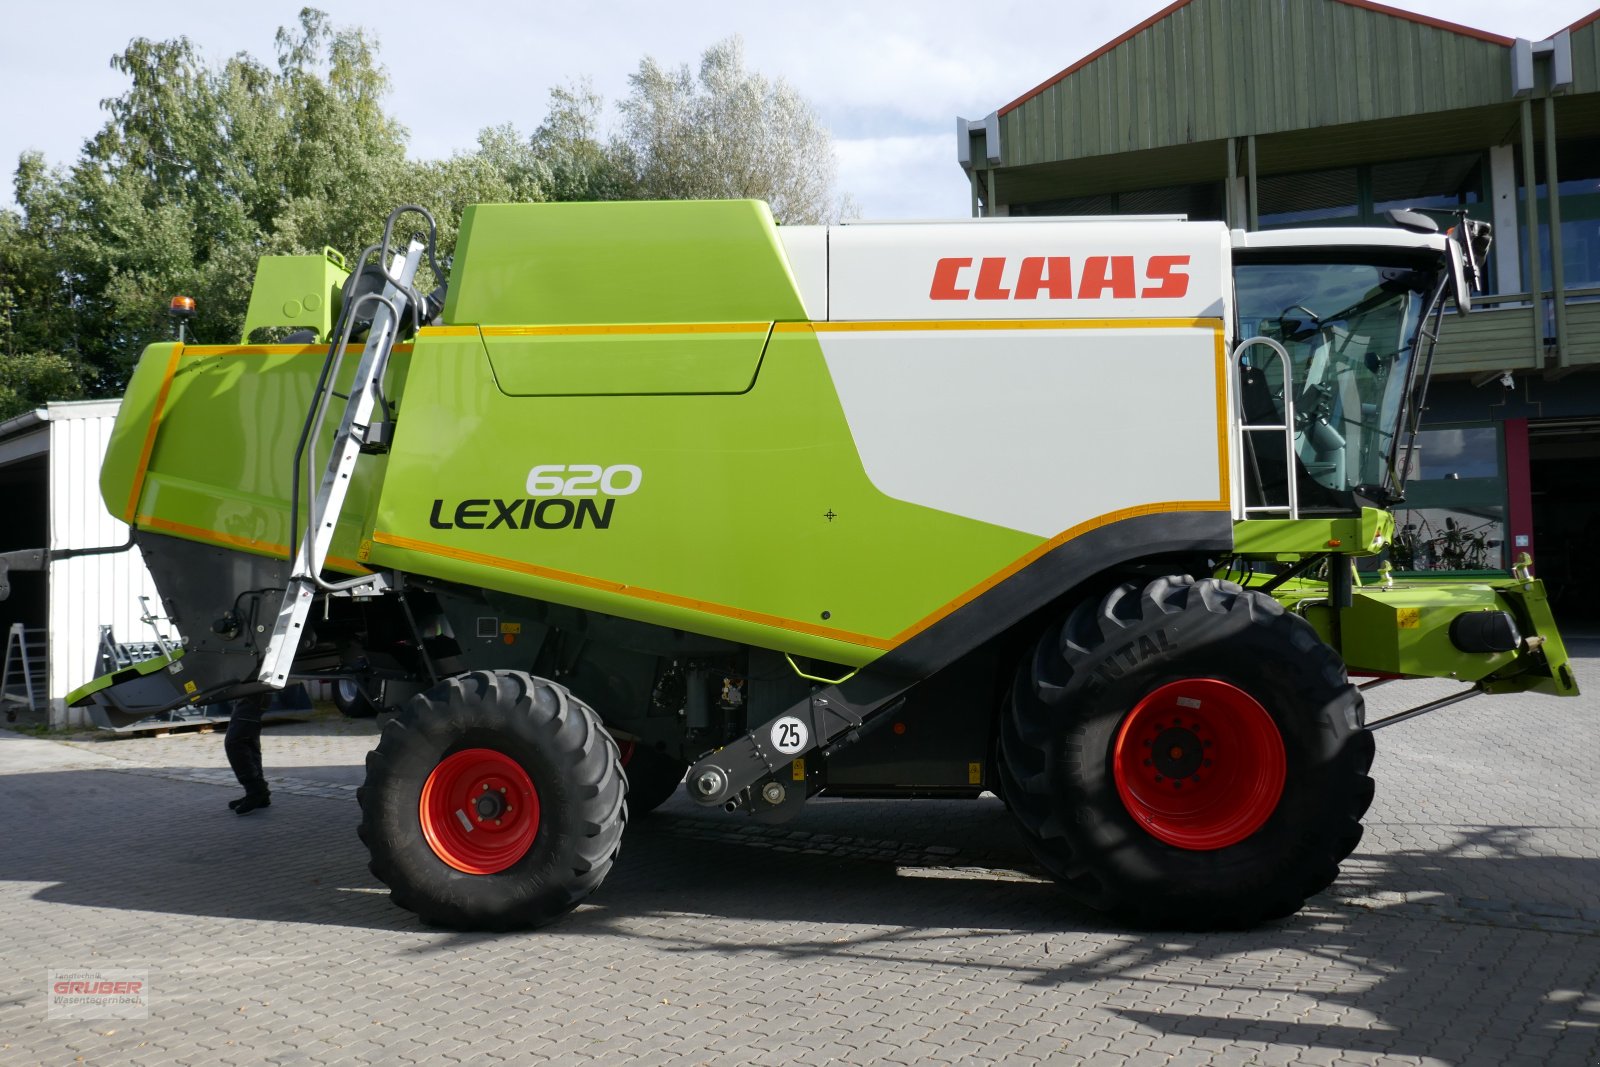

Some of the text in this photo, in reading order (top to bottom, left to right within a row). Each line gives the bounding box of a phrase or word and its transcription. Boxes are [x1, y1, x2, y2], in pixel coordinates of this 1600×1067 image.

[929, 255, 1191, 300] CLAAS
[525, 464, 643, 497] 620
[429, 498, 616, 530] LEXION
[779, 723, 800, 747] 25
